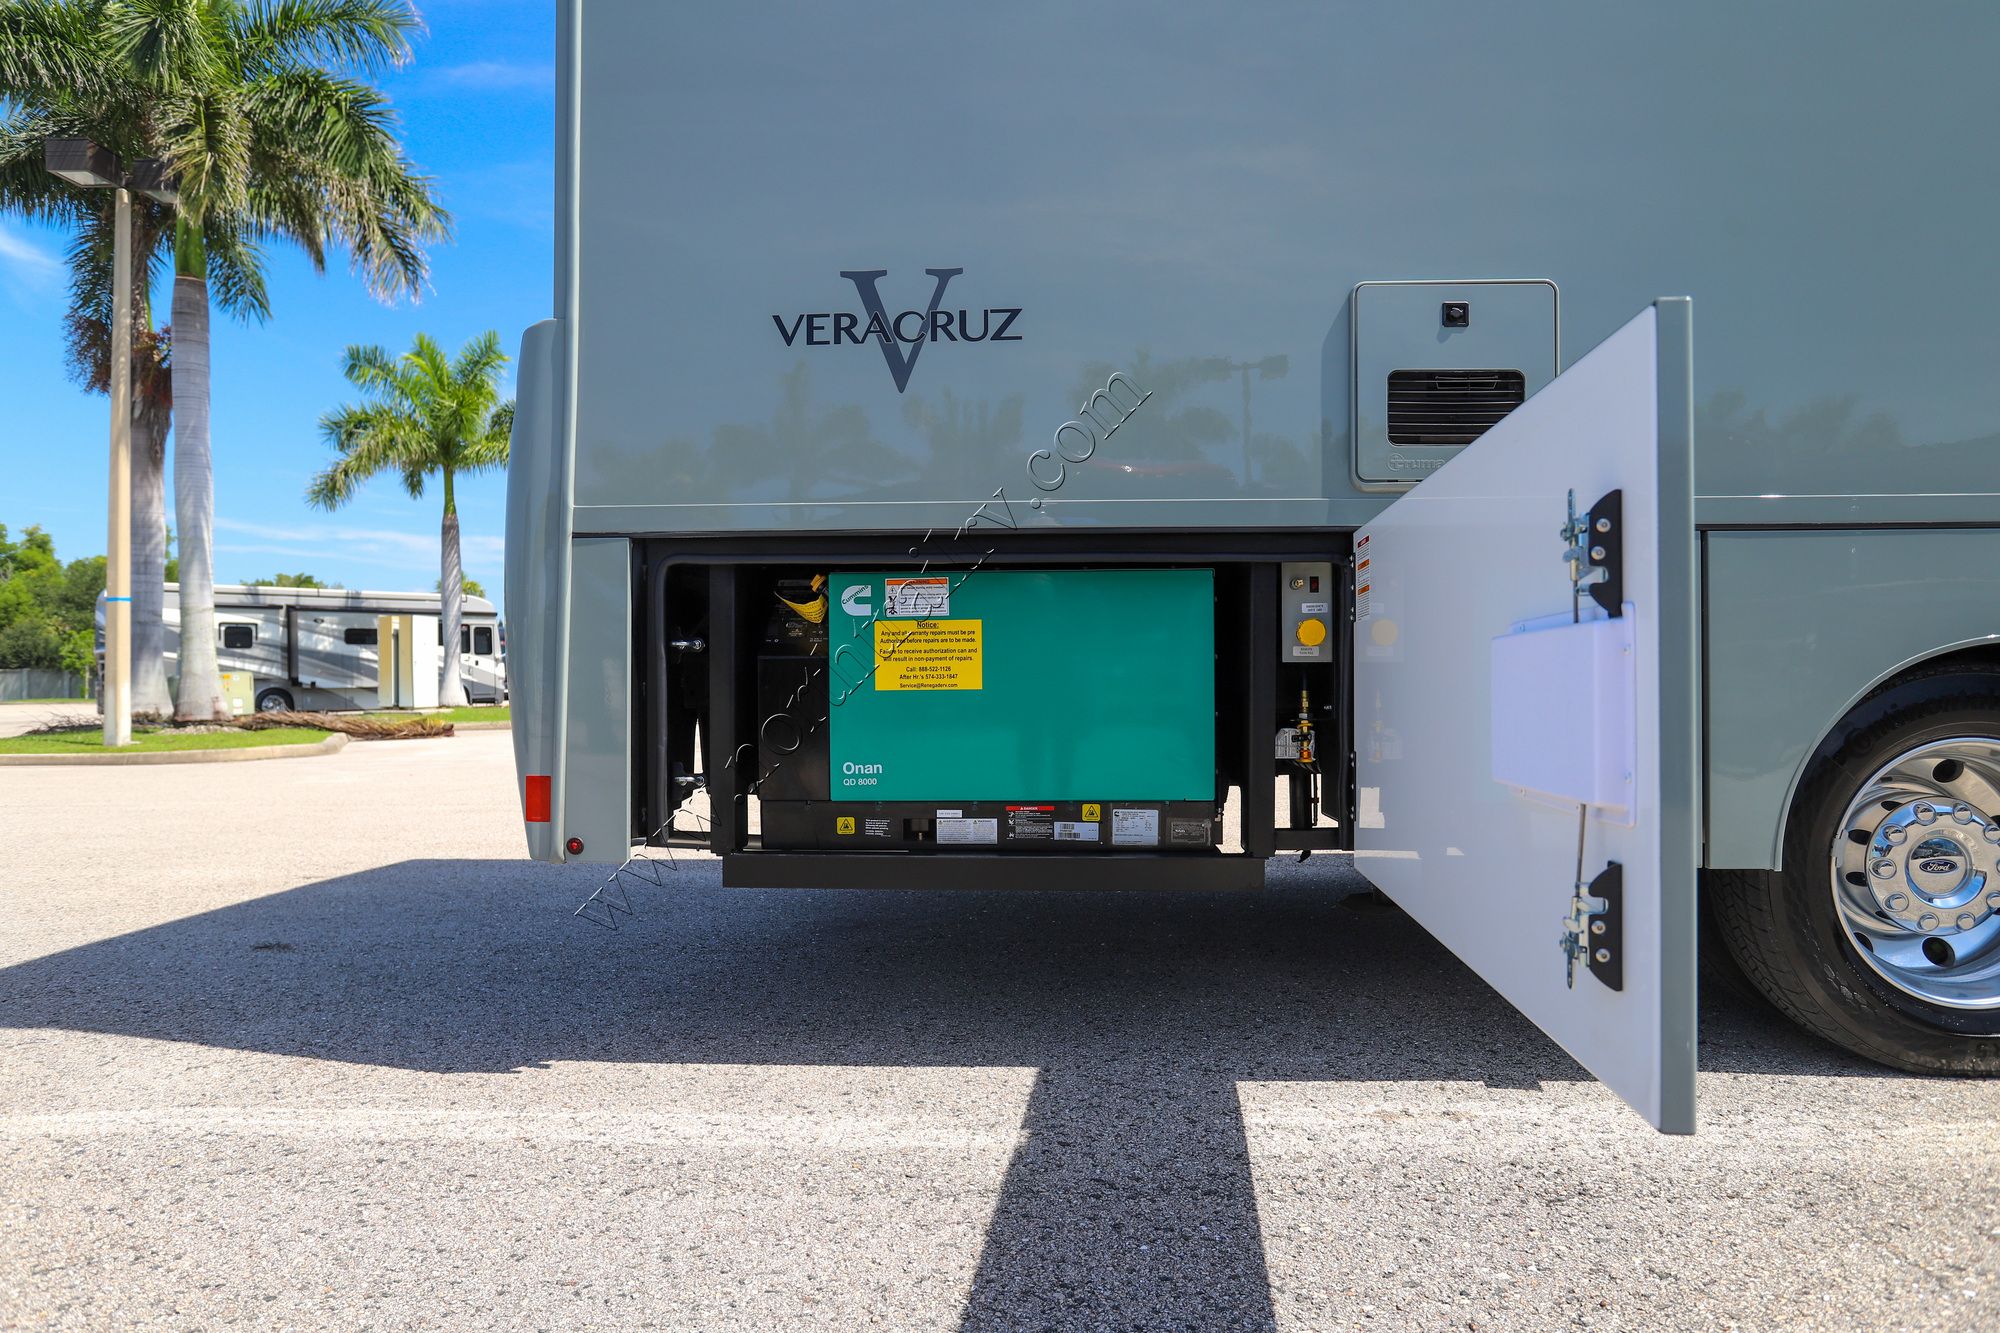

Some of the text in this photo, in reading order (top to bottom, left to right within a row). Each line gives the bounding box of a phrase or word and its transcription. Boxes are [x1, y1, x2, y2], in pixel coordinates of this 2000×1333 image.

[772, 308, 1023, 347] VERACRUZ
[842, 585, 869, 605] Cummins
[916, 621, 940, 629] Notice:
[842, 761, 883, 775] Onan
[843, 778, 878, 786] QD 8000
[1926, 861, 1951, 871] Ford
